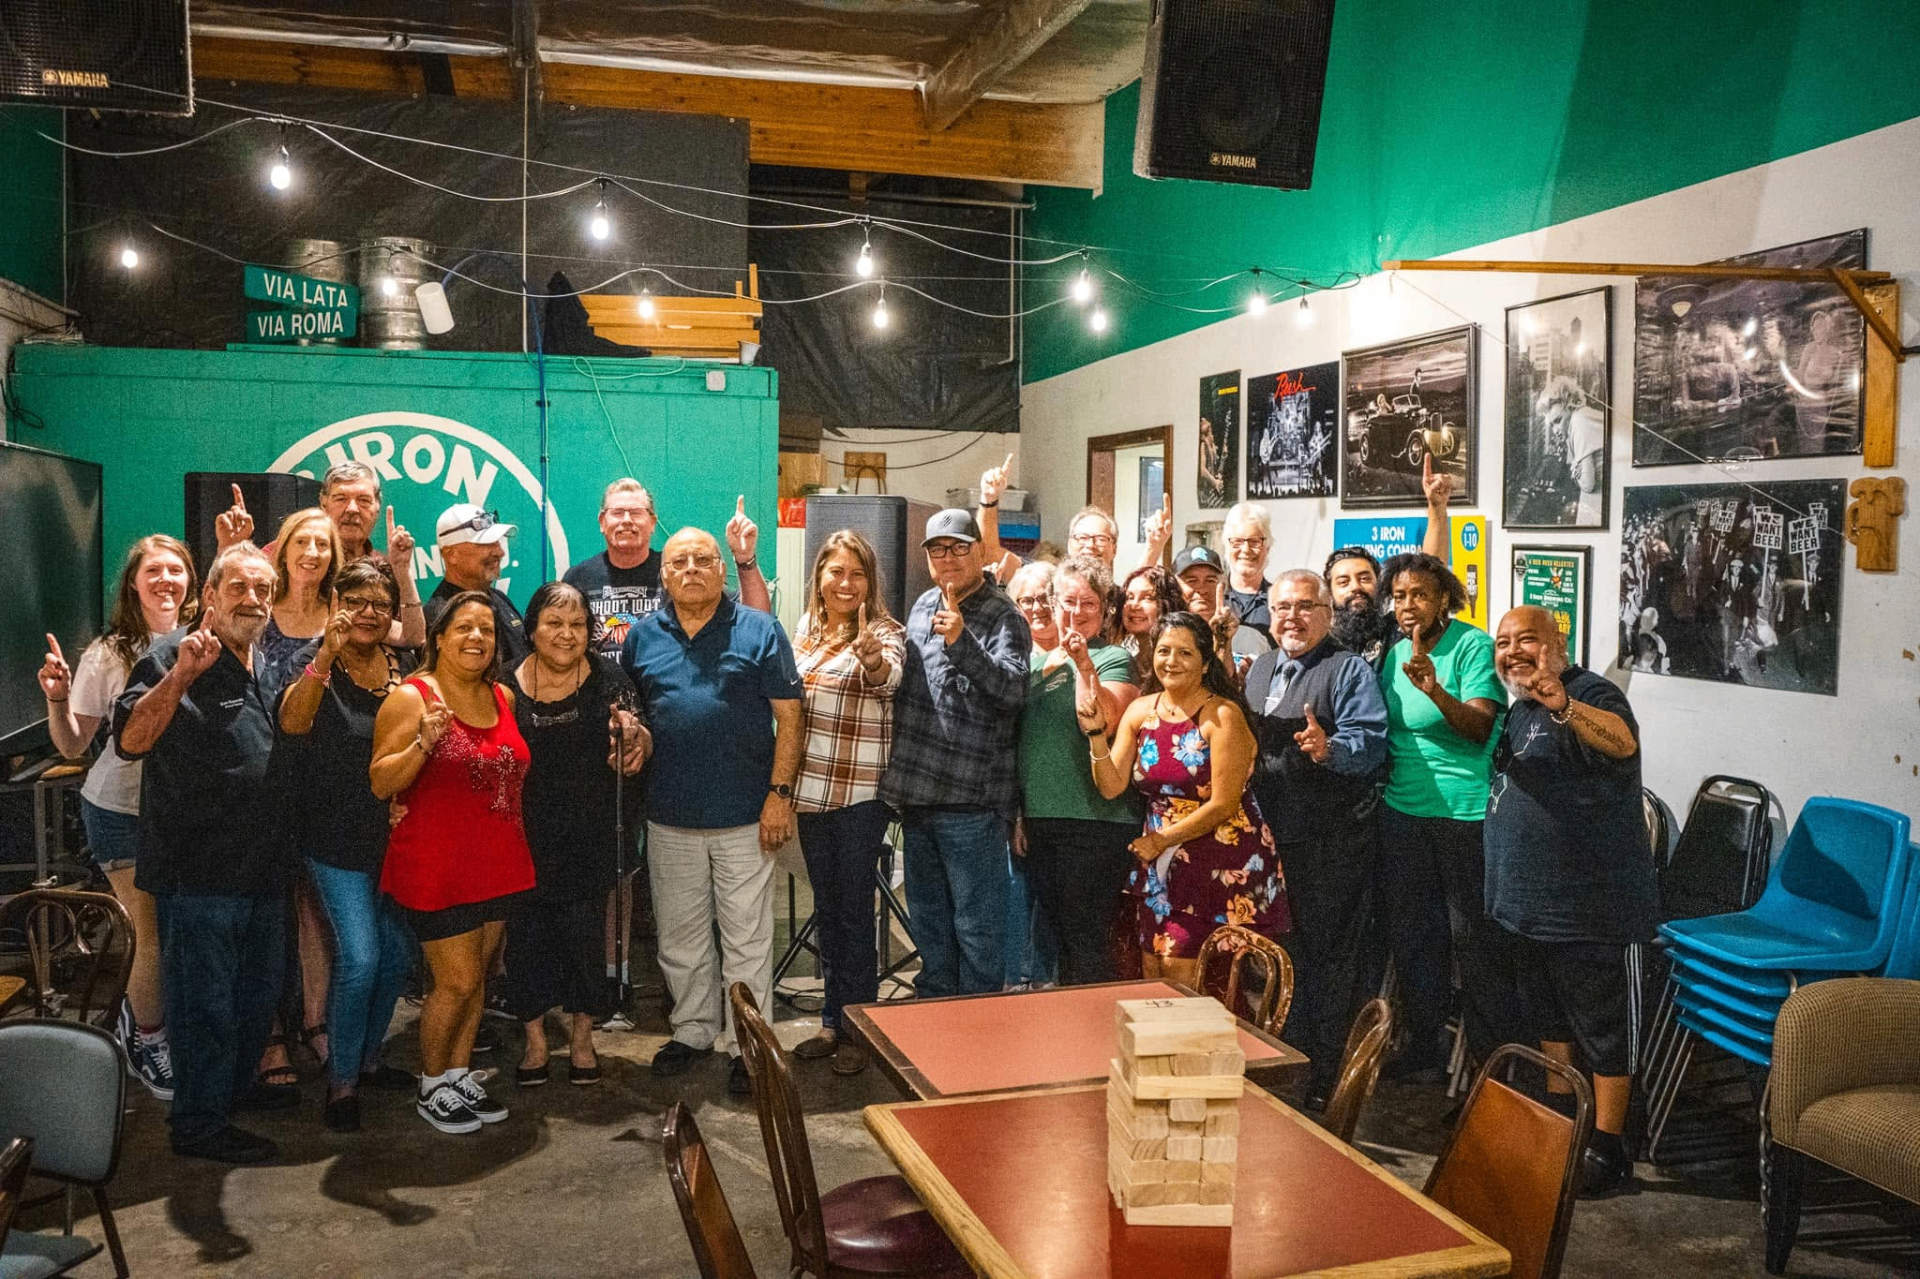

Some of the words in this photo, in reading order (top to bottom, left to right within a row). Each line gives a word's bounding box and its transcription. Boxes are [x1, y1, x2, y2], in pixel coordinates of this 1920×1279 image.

[58, 70, 109, 89] YAMAHA
[1221, 154, 1257, 169] YAMAHA
[263, 272, 296, 301] VIA
[302, 281, 348, 308] LATA
[257, 315, 286, 337] VIA
[291, 311, 344, 335] ROMA
[1759, 513, 1781, 525] WE
[1791, 517, 1816, 530] WE
[1371, 525, 1379, 541] 3
[1380, 525, 1406, 541] IRON
[1756, 523, 1782, 537] WANT
[1790, 527, 1816, 542] WANT
[1463, 533, 1478, 548] 1-10
[1755, 533, 1781, 548] BEER
[1790, 538, 1818, 553] BEER
